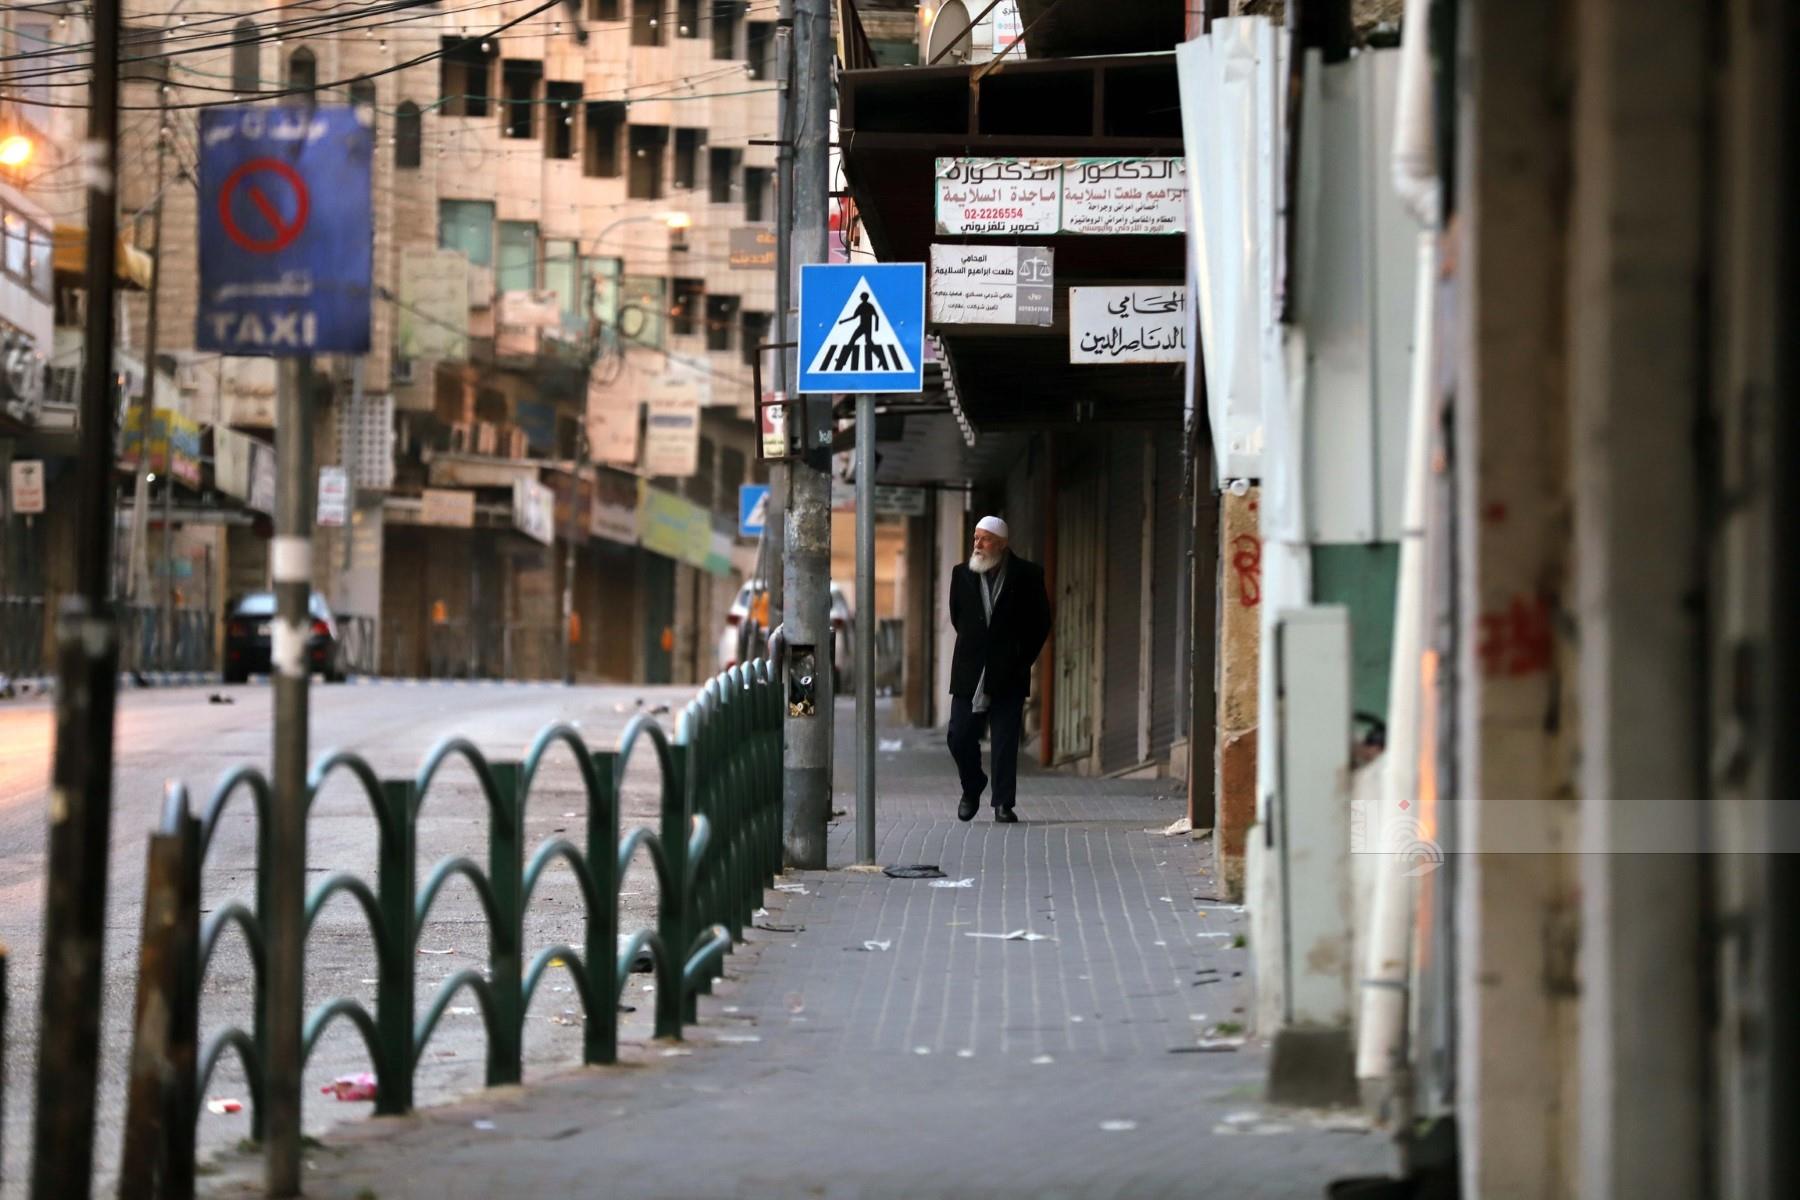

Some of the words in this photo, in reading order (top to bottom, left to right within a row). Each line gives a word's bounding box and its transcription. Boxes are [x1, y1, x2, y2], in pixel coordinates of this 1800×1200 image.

[1079, 160, 1173, 184] الدكتور
[942, 186, 1002, 207] السلايمة
[1010, 186, 1056, 206] ماجدة
[1065, 187, 1111, 204] السلايمة
[1114, 186, 1142, 201] طلعت
[964, 207, 1024, 220] 02-2226554
[960, 221, 1006, 235] تلفزيوني
[1009, 222, 1039, 235] تصوير
[960, 254, 987, 265] المحامي
[934, 265, 966, 276] السلايمة
[992, 267, 1014, 276] طلعت
[208, 311, 317, 347] TAXI
